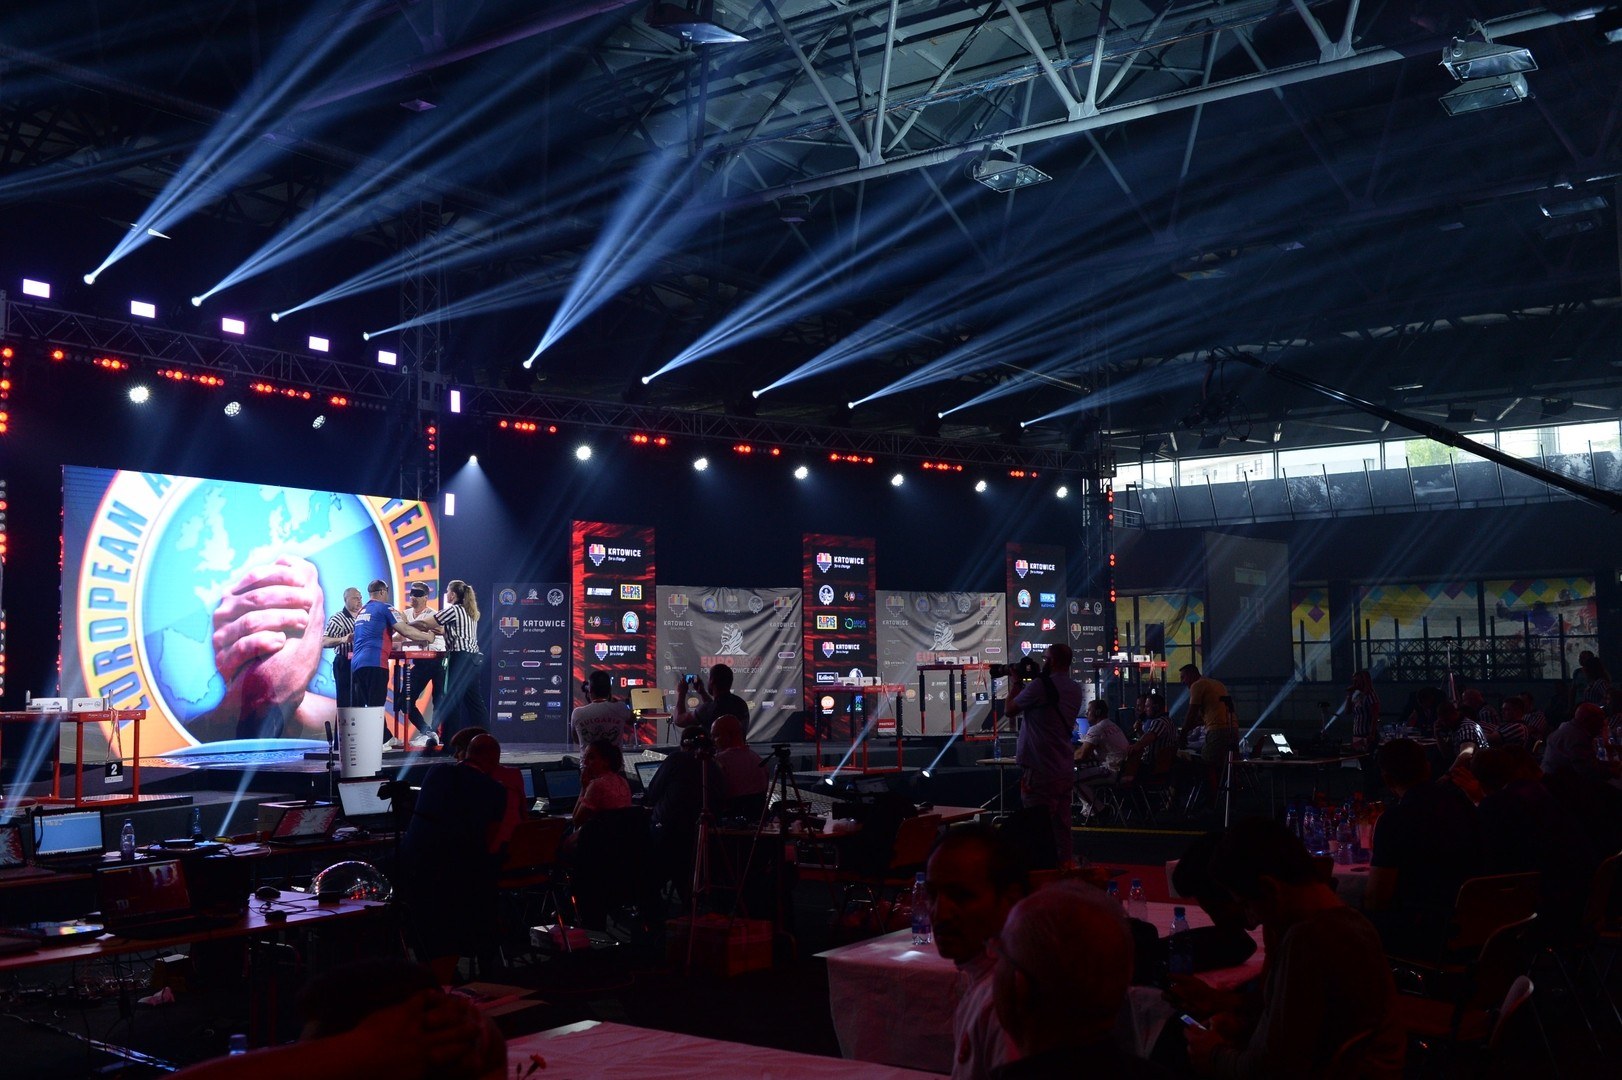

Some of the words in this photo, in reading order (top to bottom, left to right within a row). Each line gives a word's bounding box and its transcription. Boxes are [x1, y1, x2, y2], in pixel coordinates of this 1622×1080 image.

[608, 548, 641, 557] KATOWICE
[834, 556, 864, 565] KATOWICE
[1030, 563, 1055, 571] KATOWICE
[111, 763, 118, 776] 2
